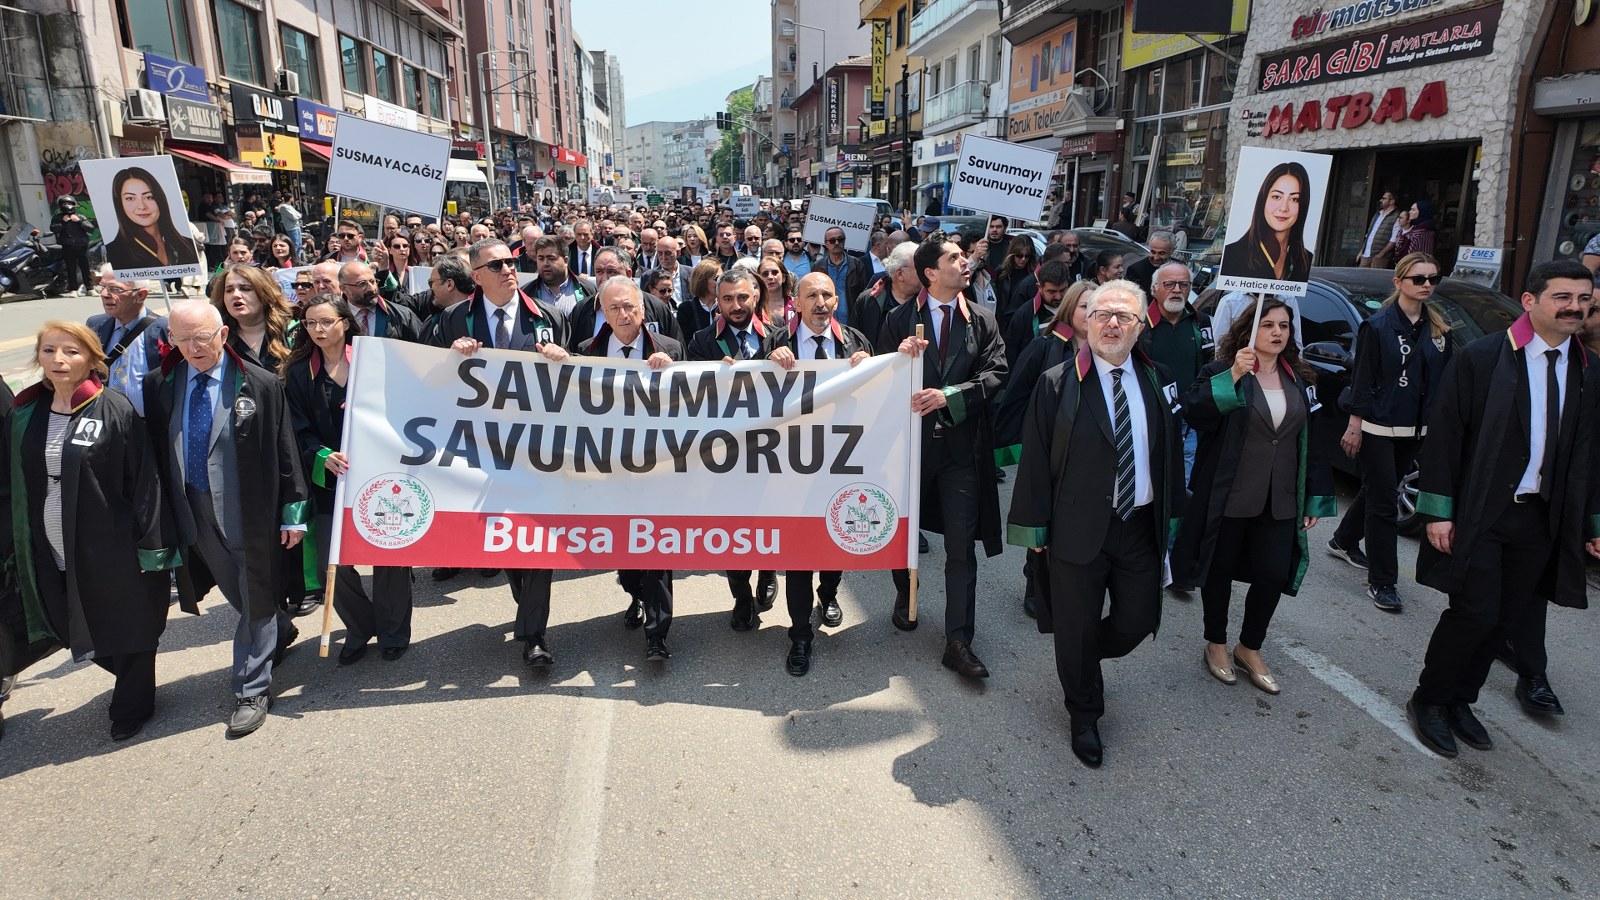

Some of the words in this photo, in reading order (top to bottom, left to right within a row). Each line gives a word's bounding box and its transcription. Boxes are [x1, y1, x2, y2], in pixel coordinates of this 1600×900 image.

[874, 36, 882, 94] KARTAL
[1262, 53, 1320, 90] ŞAKA
[1326, 34, 1388, 75] GİBİ
[1390, 21, 1482, 54] FİYATLARLA
[1386, 51, 1415, 65] Teknoloji
[1415, 52, 1425, 60] ve
[1425, 46, 1449, 58] Sistem
[186, 105, 211, 128] MAKAS
[211, 110, 220, 129] 16
[1260, 81, 1449, 138] MATBAA
[336, 146, 443, 181] SUSMAYACAĞIZ
[968, 155, 1042, 183] Savunmayı
[958, 171, 1044, 199] Savunuyoruz
[809, 213, 871, 232] SUSMAYACAĞIZ
[1471, 249, 1495, 258] EMES
[133, 269, 160, 278] Hatice
[1224, 279, 1238, 287] Av.
[1240, 280, 1268, 290] Hatice
[1269, 282, 1302, 293] Kocaefe
[456, 357, 817, 419] SAVUNMAYI
[400, 416, 864, 475] SAVUNUYORUZ
[367, 534, 387, 546] BURSA
[388, 536, 414, 546] BAROSU
[483, 516, 613, 553] Bursa
[627, 518, 780, 555] Barosu
[840, 542, 859, 552] BURSA
[859, 543, 882, 553] BAROSU
